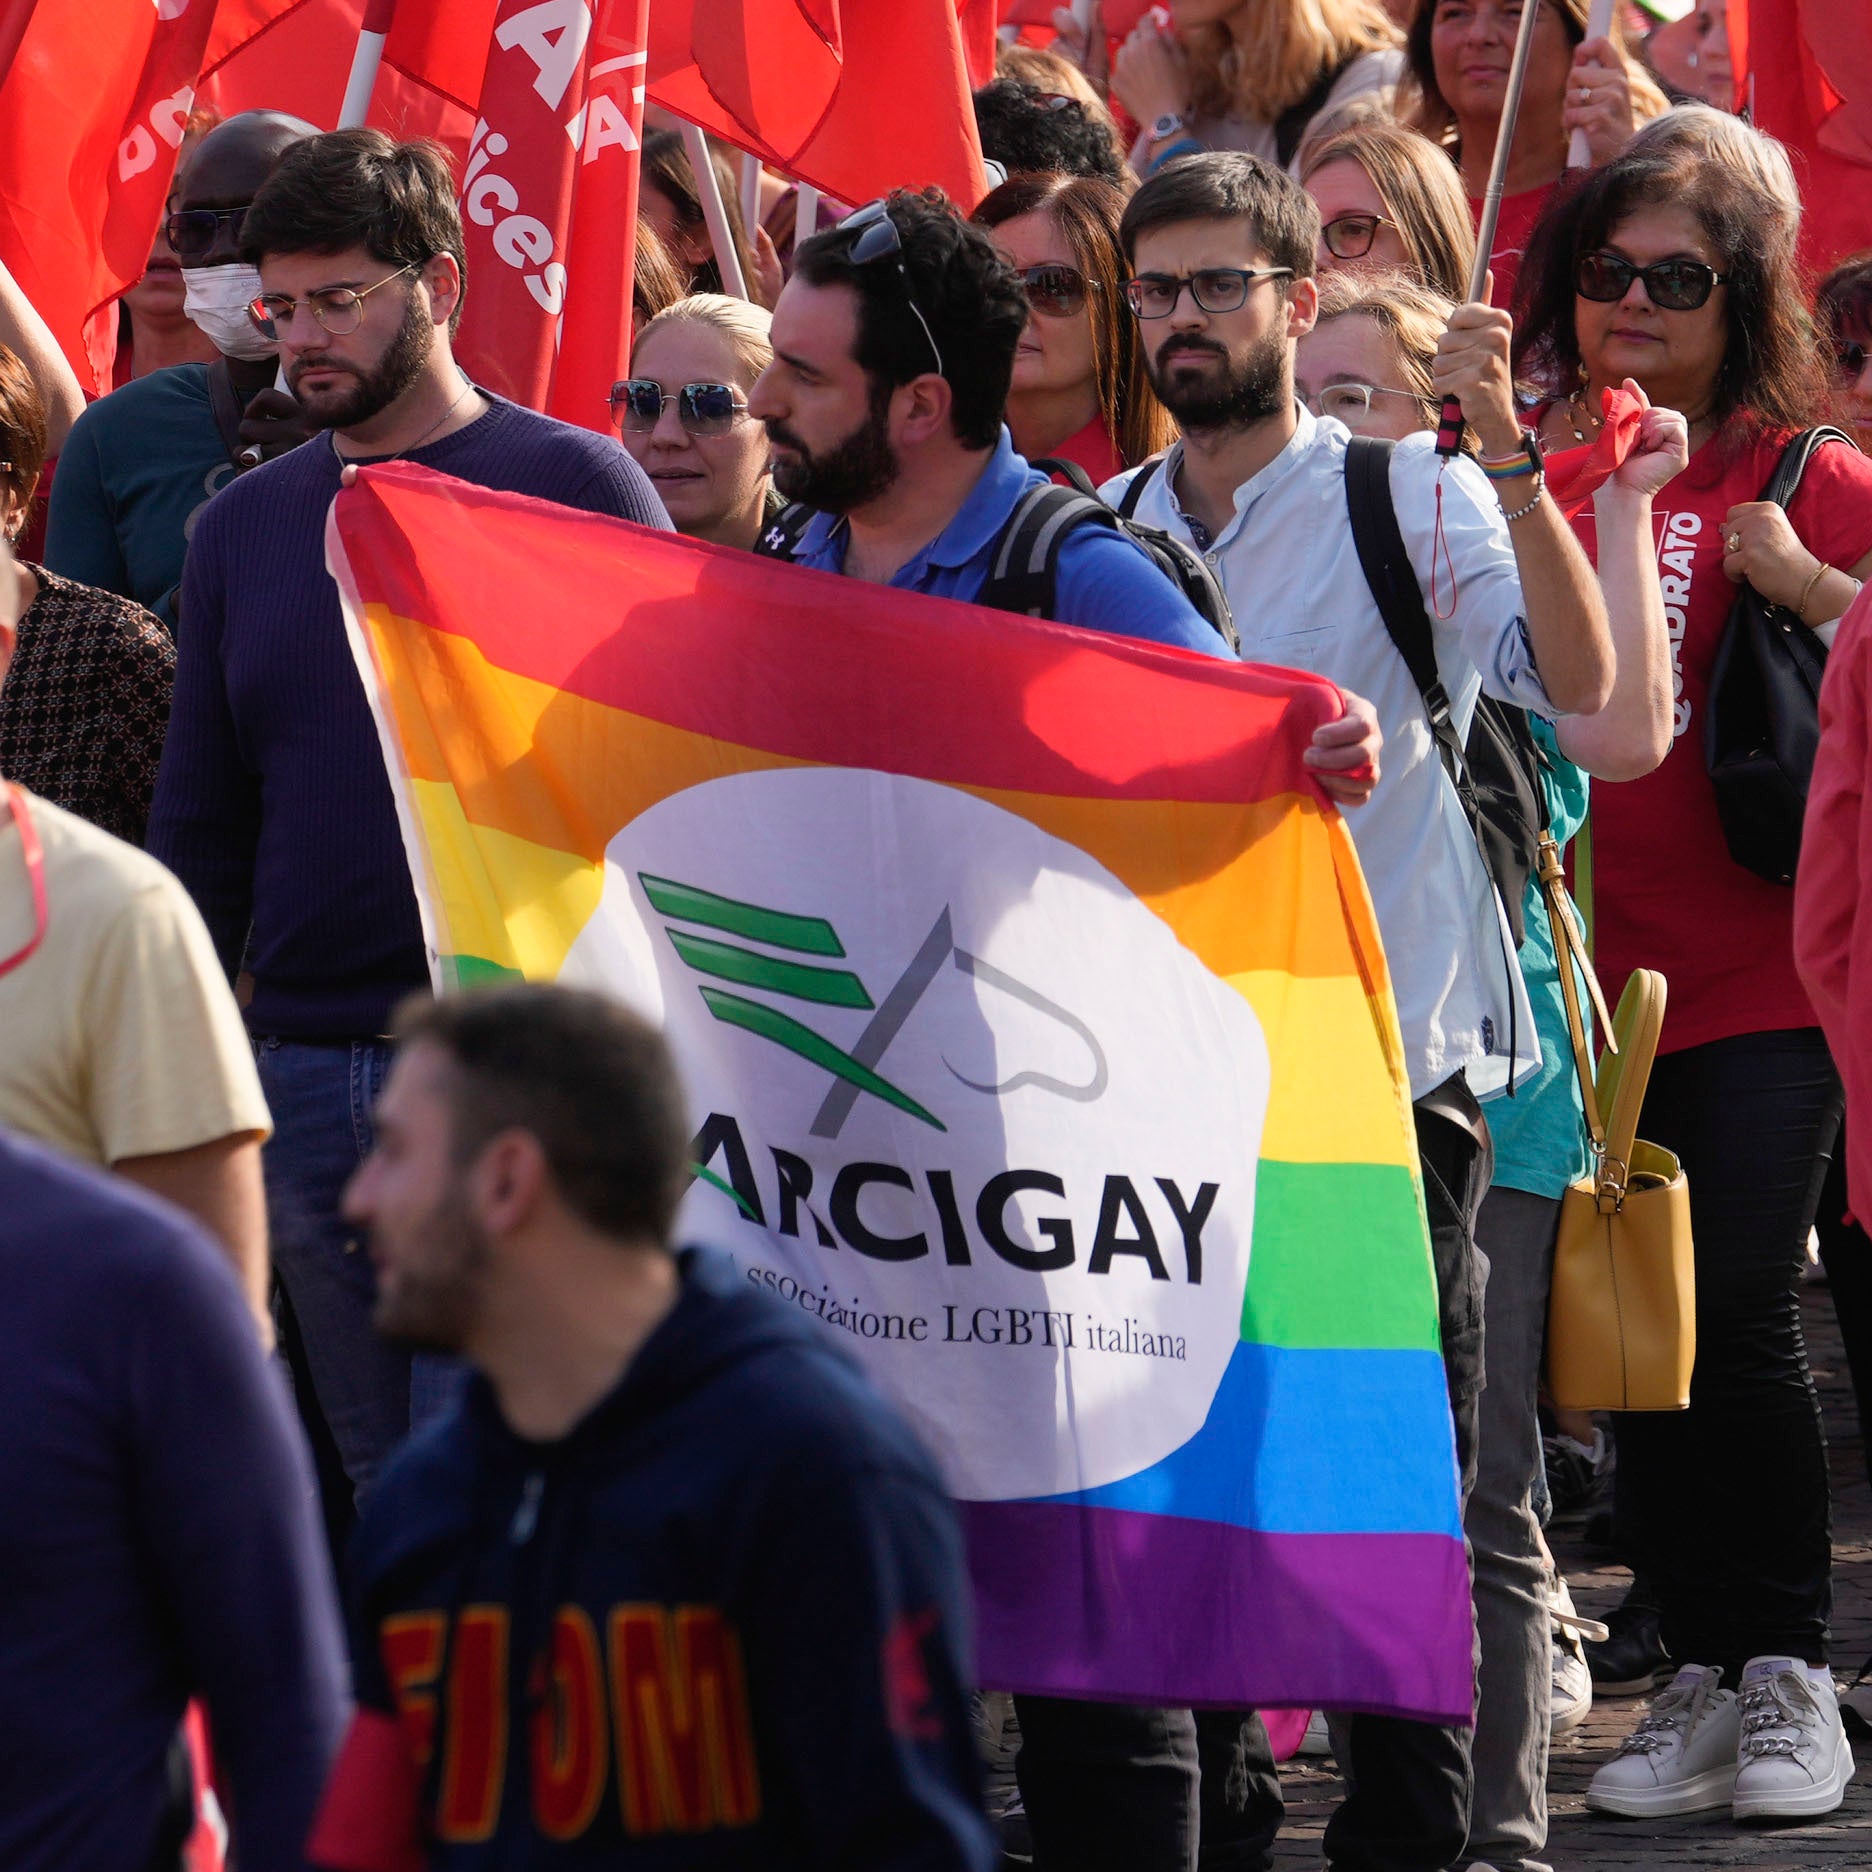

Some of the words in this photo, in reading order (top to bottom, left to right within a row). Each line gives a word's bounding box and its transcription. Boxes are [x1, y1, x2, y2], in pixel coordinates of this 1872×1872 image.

[678, 1111, 1221, 1286] ARCIGAY
[941, 1304, 1077, 1349] LGBTI
[1085, 1314, 1187, 1362] italiana
